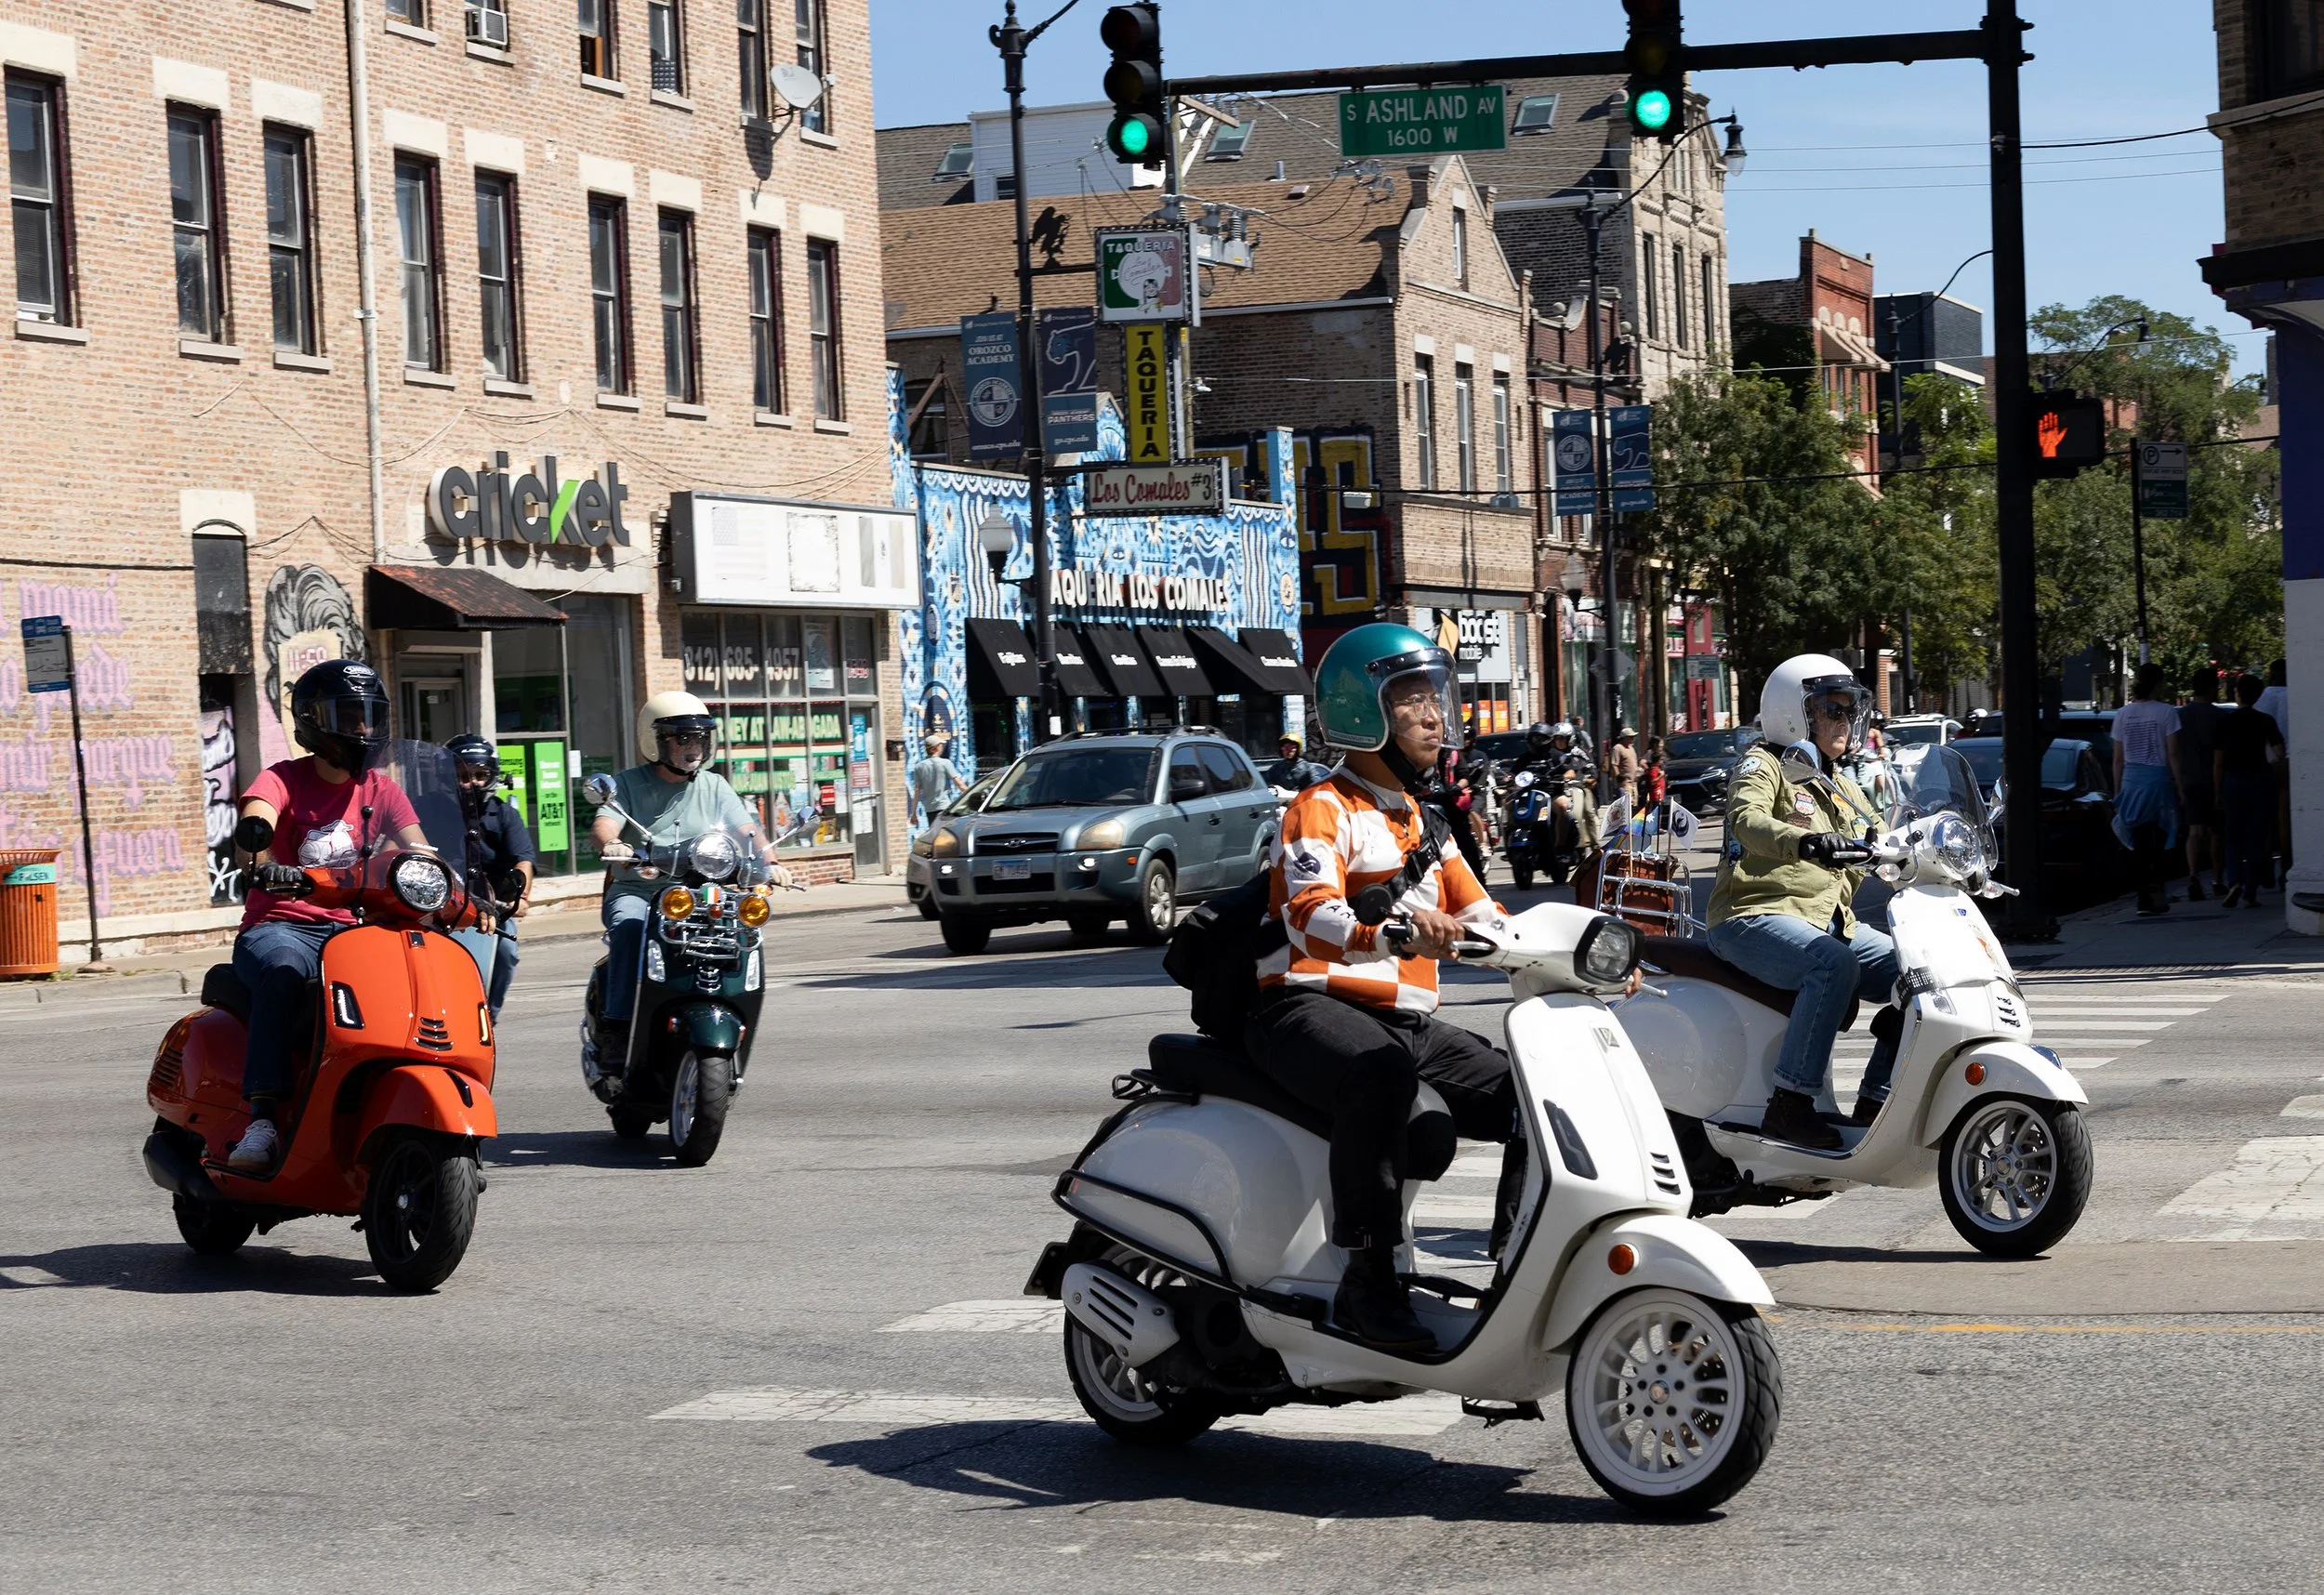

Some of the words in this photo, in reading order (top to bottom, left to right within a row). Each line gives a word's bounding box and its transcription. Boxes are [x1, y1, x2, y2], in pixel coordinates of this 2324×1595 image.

[1347, 104, 1357, 121] S
[1366, 95, 1468, 124] ASHLAND
[1477, 97, 1497, 114] AV
[1387, 127, 1433, 147] 1600
[1443, 126, 1459, 143] W
[1106, 241, 1176, 254] TAQUERIA
[967, 353, 1016, 365] ACADEMY
[968, 345, 1012, 355] OROZCO
[1134, 331, 1161, 457] TAQUERIA
[1048, 414, 1095, 425] PANTHERS
[433, 451, 630, 547] cricket
[1092, 473, 1120, 503] Los
[1125, 471, 1190, 505] Comales
[1129, 573, 1159, 610] LOS
[1164, 576, 1232, 614] COMALES
[1458, 611, 1499, 644] boost
[724, 646, 759, 681] 685-
[750, 716, 765, 742] AT
[540, 802, 564, 820] AT&T
